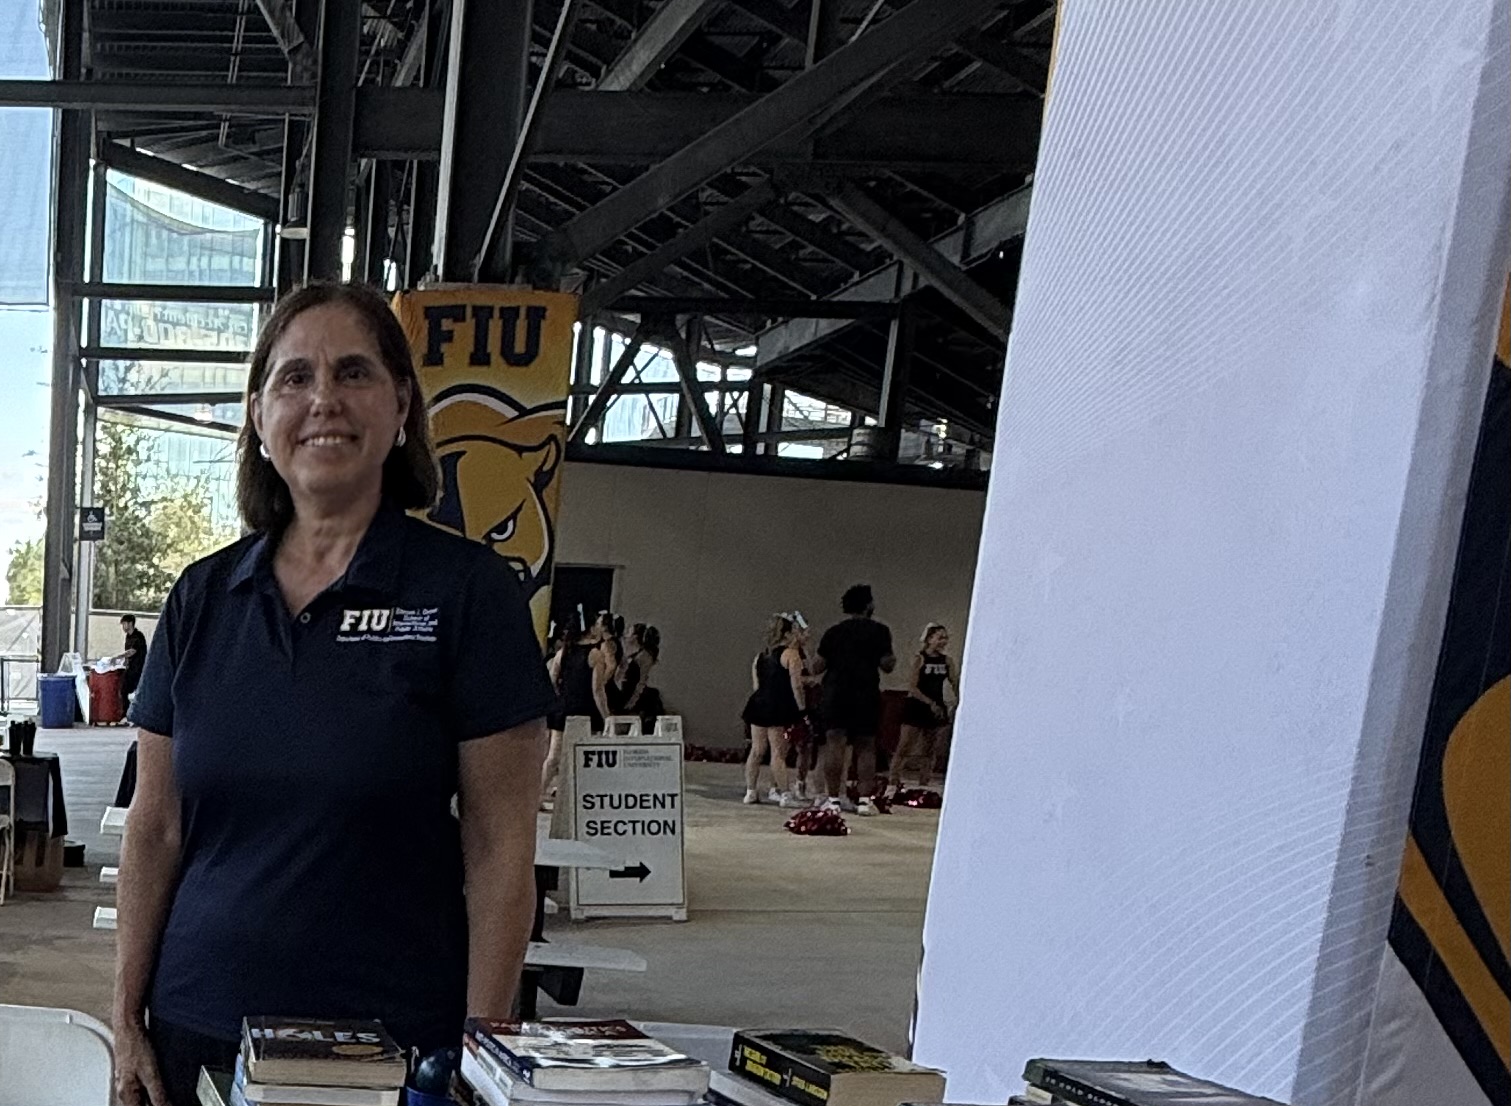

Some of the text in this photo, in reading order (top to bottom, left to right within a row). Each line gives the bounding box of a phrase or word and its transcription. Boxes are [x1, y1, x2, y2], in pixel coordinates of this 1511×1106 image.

[422, 304, 548, 367] FIU
[340, 608, 390, 632] FIU
[583, 750, 618, 768] FIU
[582, 793, 679, 810] STUDENT
[585, 820, 676, 836] SECTION
